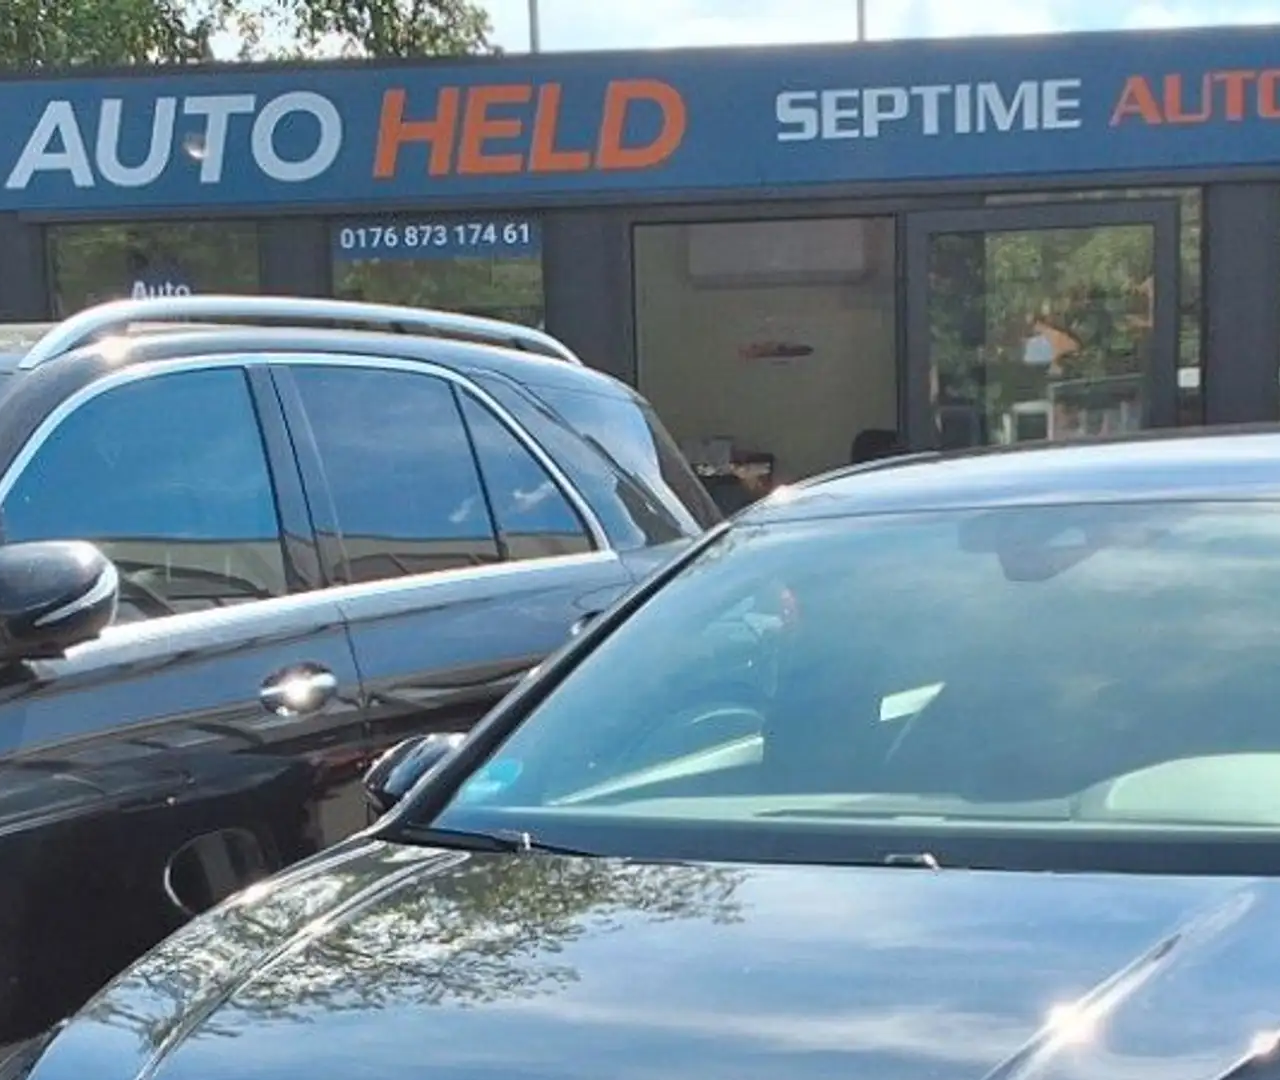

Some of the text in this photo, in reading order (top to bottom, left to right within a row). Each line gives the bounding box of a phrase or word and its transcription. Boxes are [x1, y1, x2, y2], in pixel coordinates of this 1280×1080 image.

[5, 79, 687, 189] AUTO HELD
[776, 78, 1082, 141] SEPTIME
[339, 221, 530, 249] 0176 873 174 61
